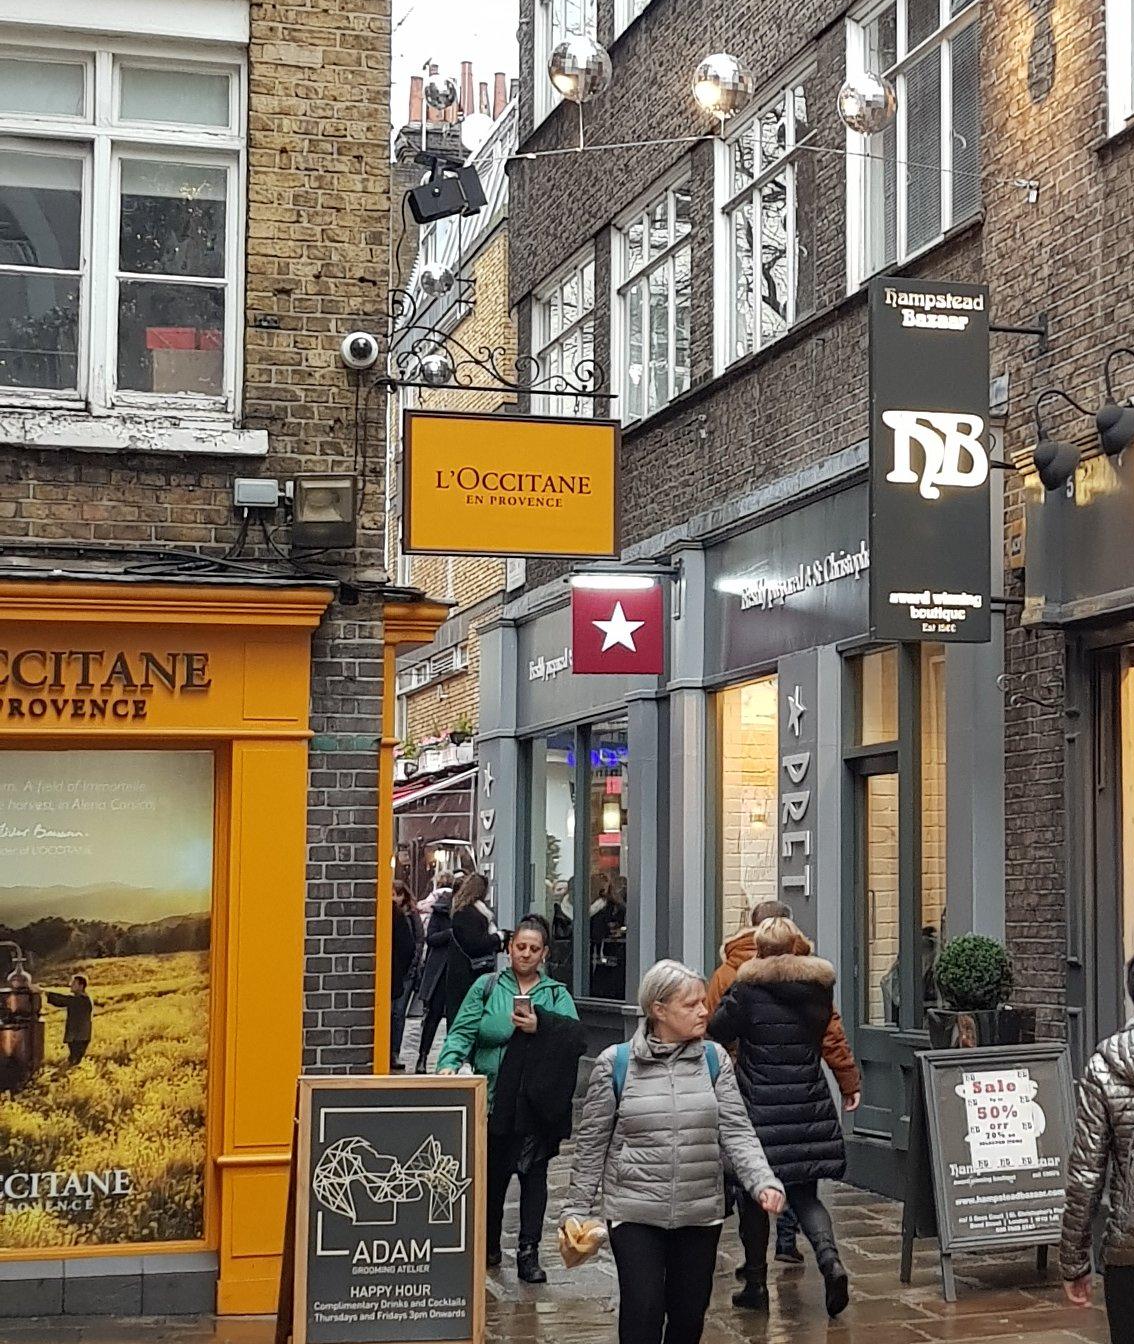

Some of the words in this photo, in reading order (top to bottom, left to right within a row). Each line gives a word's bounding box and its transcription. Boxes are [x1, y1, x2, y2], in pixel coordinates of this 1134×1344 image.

[466, 494, 484, 505] EN
[490, 495, 563, 508] PROVENCE
[0, 649, 212, 692] CITANE
[0, 697, 147, 719] ROVENCE
[782, 752, 811, 896] PRET
[972, 1079, 1016, 1094] Sale
[977, 1104, 1018, 1120] 50%
[0, 1169, 136, 1199] CITANE
[352, 1238, 431, 1264] ADAM
[352, 1265, 396, 1275] GROOMING
[397, 1264, 430, 1274] ATELIER
[350, 1285, 392, 1298] HAPPY
[396, 1284, 431, 1297] HOUR
[314, 1300, 379, 1312] Complimentary
[380, 1299, 408, 1309] Drinks
[411, 1299, 426, 1308] and
[428, 1297, 466, 1307] Cocktails
[314, 1312, 358, 1323] Thursdays
[360, 1311, 375, 1321] and
[377, 1310, 407, 1322] Fridays
[409, 1310, 427, 1321] 3pm
[429, 1308, 466, 1319] Onwards
